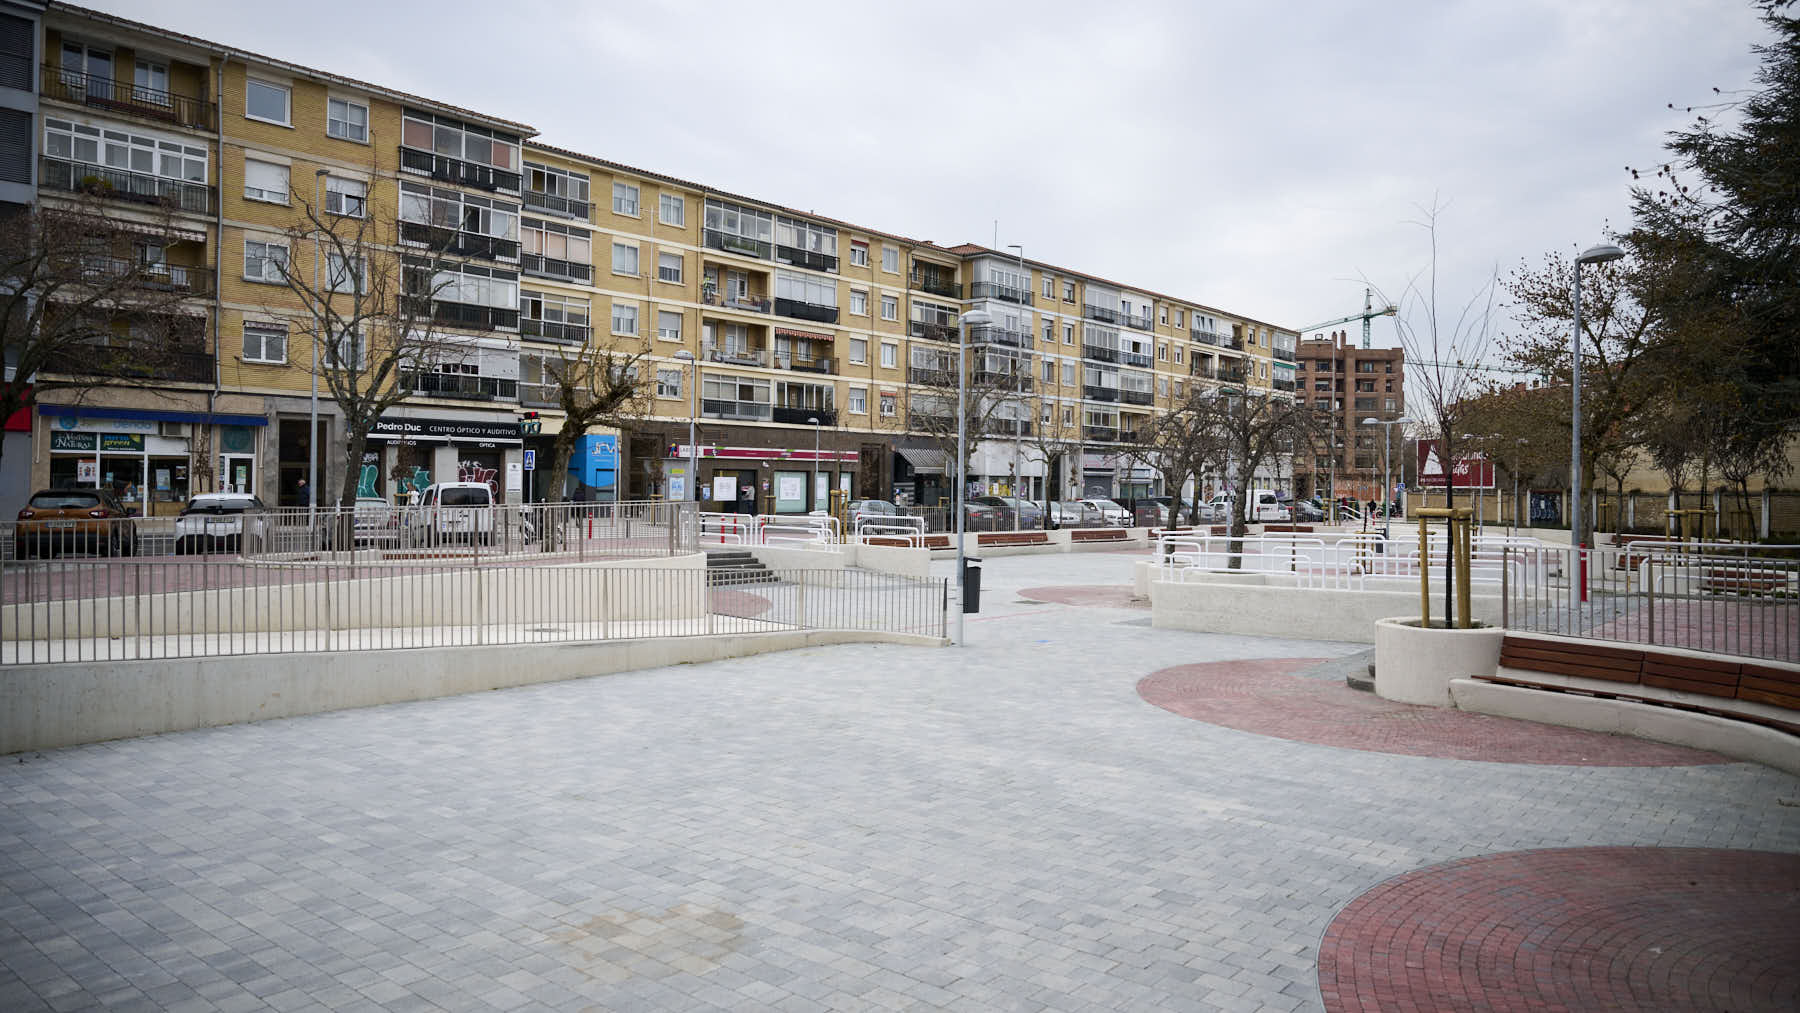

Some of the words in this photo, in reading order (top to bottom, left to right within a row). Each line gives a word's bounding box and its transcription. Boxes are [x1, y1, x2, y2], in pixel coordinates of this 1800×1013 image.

[376, 422, 403, 431] Pedro
[404, 424, 422, 432] Duc
[429, 425, 456, 433] CENTRO
[456, 425, 481, 434] ÓPTICO
[486, 428, 517, 436] AUDITIVO
